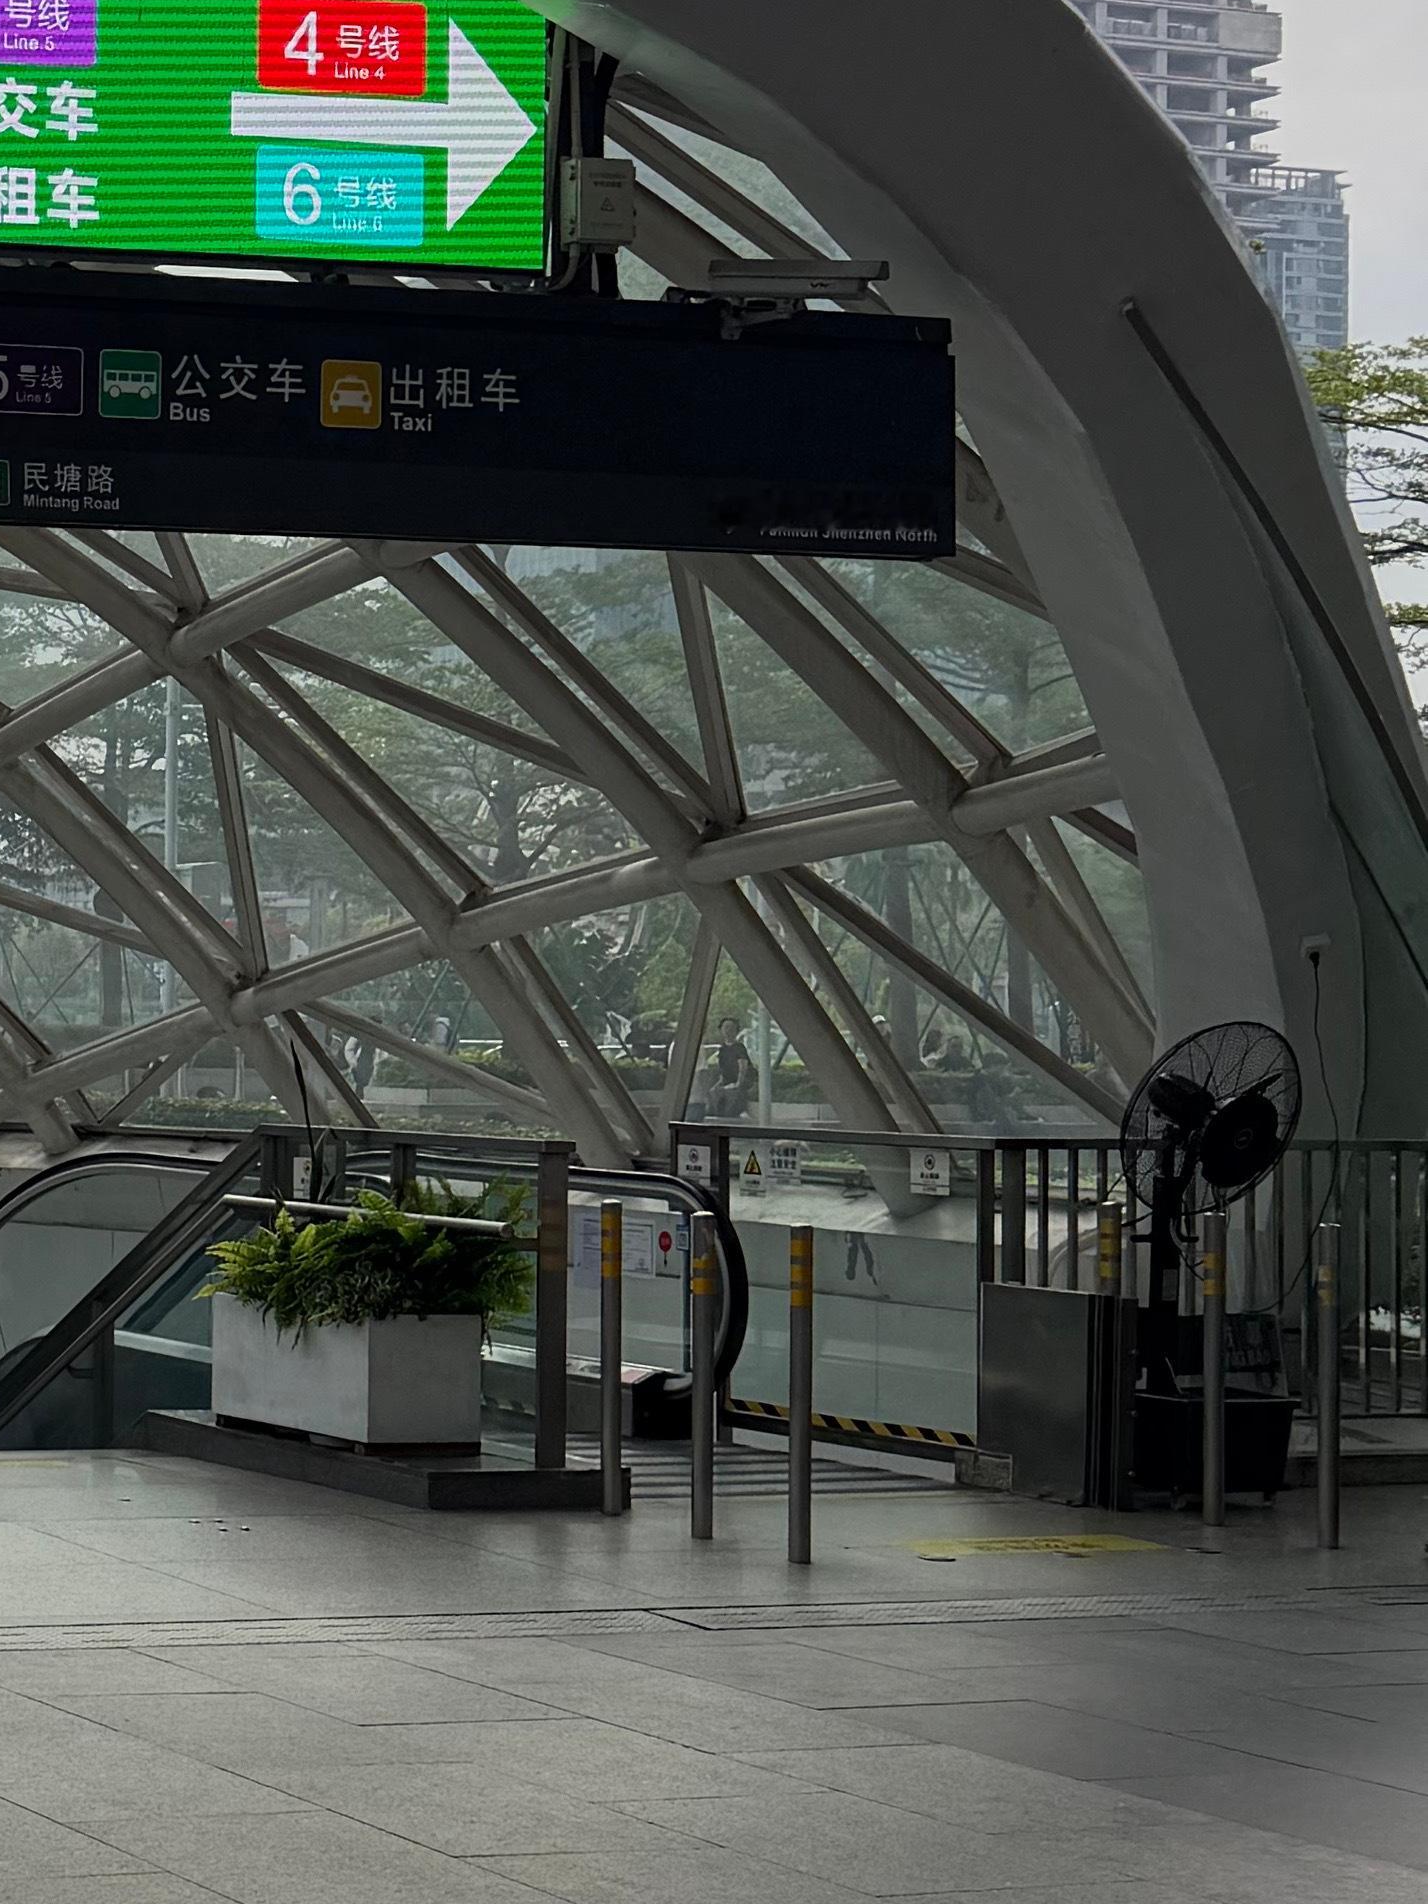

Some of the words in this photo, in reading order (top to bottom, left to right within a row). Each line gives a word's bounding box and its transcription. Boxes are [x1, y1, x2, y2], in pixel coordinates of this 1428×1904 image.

[3, 32, 40, 53] Line
[335, 62, 370, 80] Line
[374, 64, 386, 80] 4
[170, 354, 307, 402] 公交车
[390, 364, 521, 412] 出租车
[169, 402, 212, 423] Bus
[390, 412, 433, 433] Taxi
[23, 461, 116, 496] 民塘路
[22, 495, 81, 512] Mintang
[83, 496, 121, 512] Road
